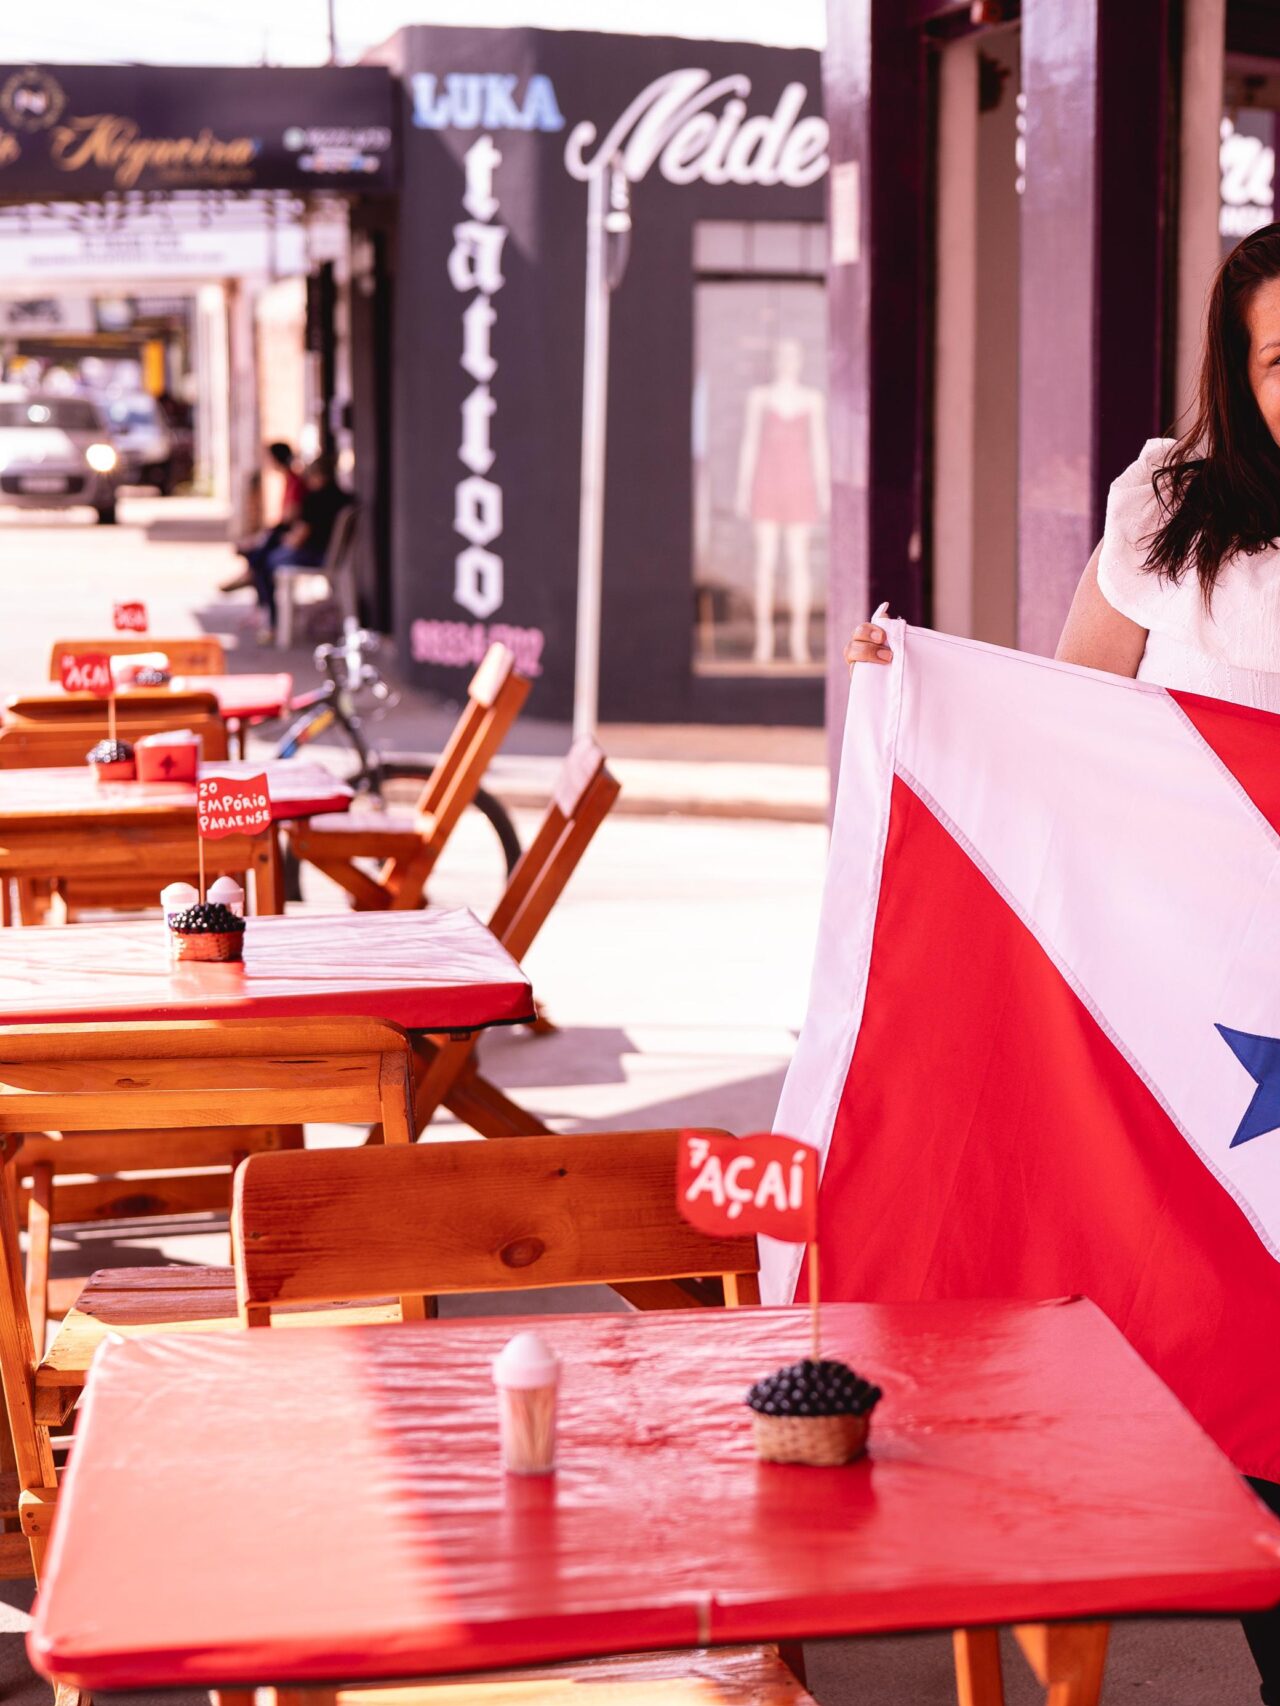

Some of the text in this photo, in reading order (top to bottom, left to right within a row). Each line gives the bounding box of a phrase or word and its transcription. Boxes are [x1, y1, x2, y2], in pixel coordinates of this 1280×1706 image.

[412, 72, 566, 132] LUKA
[564, 67, 831, 187] Neide
[199, 793, 267, 815] EMPÓRIO
[200, 781, 218, 797] 20
[685, 1149, 807, 1220] AÇAÍ
